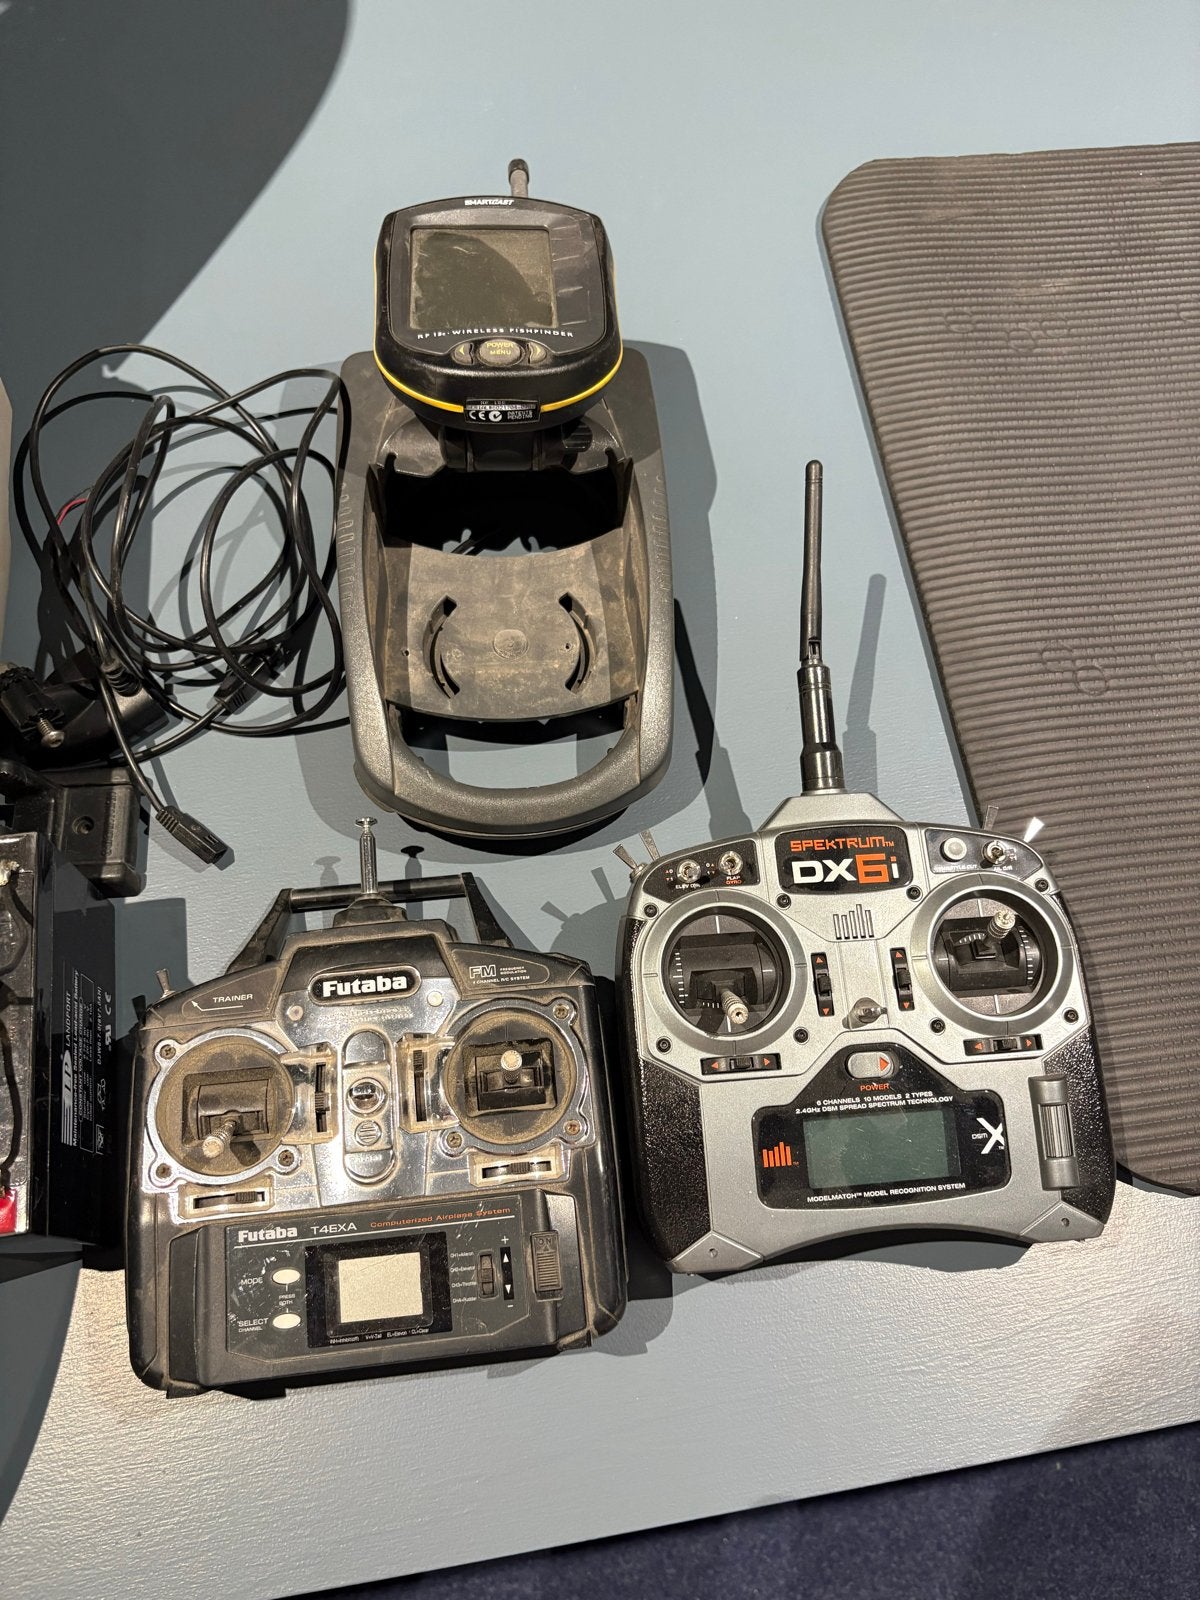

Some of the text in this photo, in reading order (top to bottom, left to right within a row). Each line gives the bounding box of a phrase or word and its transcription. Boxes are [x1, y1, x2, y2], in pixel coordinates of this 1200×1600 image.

[509, 327, 574, 338] FISHFINDER
[791, 853, 900, 884] DX6i
[469, 964, 497, 979] FM
[322, 976, 408, 998] Futaba
[212, 993, 254, 1003] TRAINER
[860, 1083, 890, 1092] POWER
[795, 1106, 821, 1114] 2.4GHz
[839, 1102, 867, 1111] SPREAD
[868, 1099, 906, 1109] SPECTRUM
[907, 1096, 954, 1105] TECHNOLOGY
[823, 1097, 860, 1105] CHANNELS
[863, 1189, 889, 1198] MODEL
[889, 1185, 937, 1196] RECOGNITION
[937, 1182, 966, 1191] SYSTEM
[238, 1208, 511, 1242] Futaba T4EXA Computerized Airplane System
[240, 1277, 263, 1286] MODE
[239, 1317, 269, 1327] SELECT
[239, 1325, 263, 1333] CHANNEL
